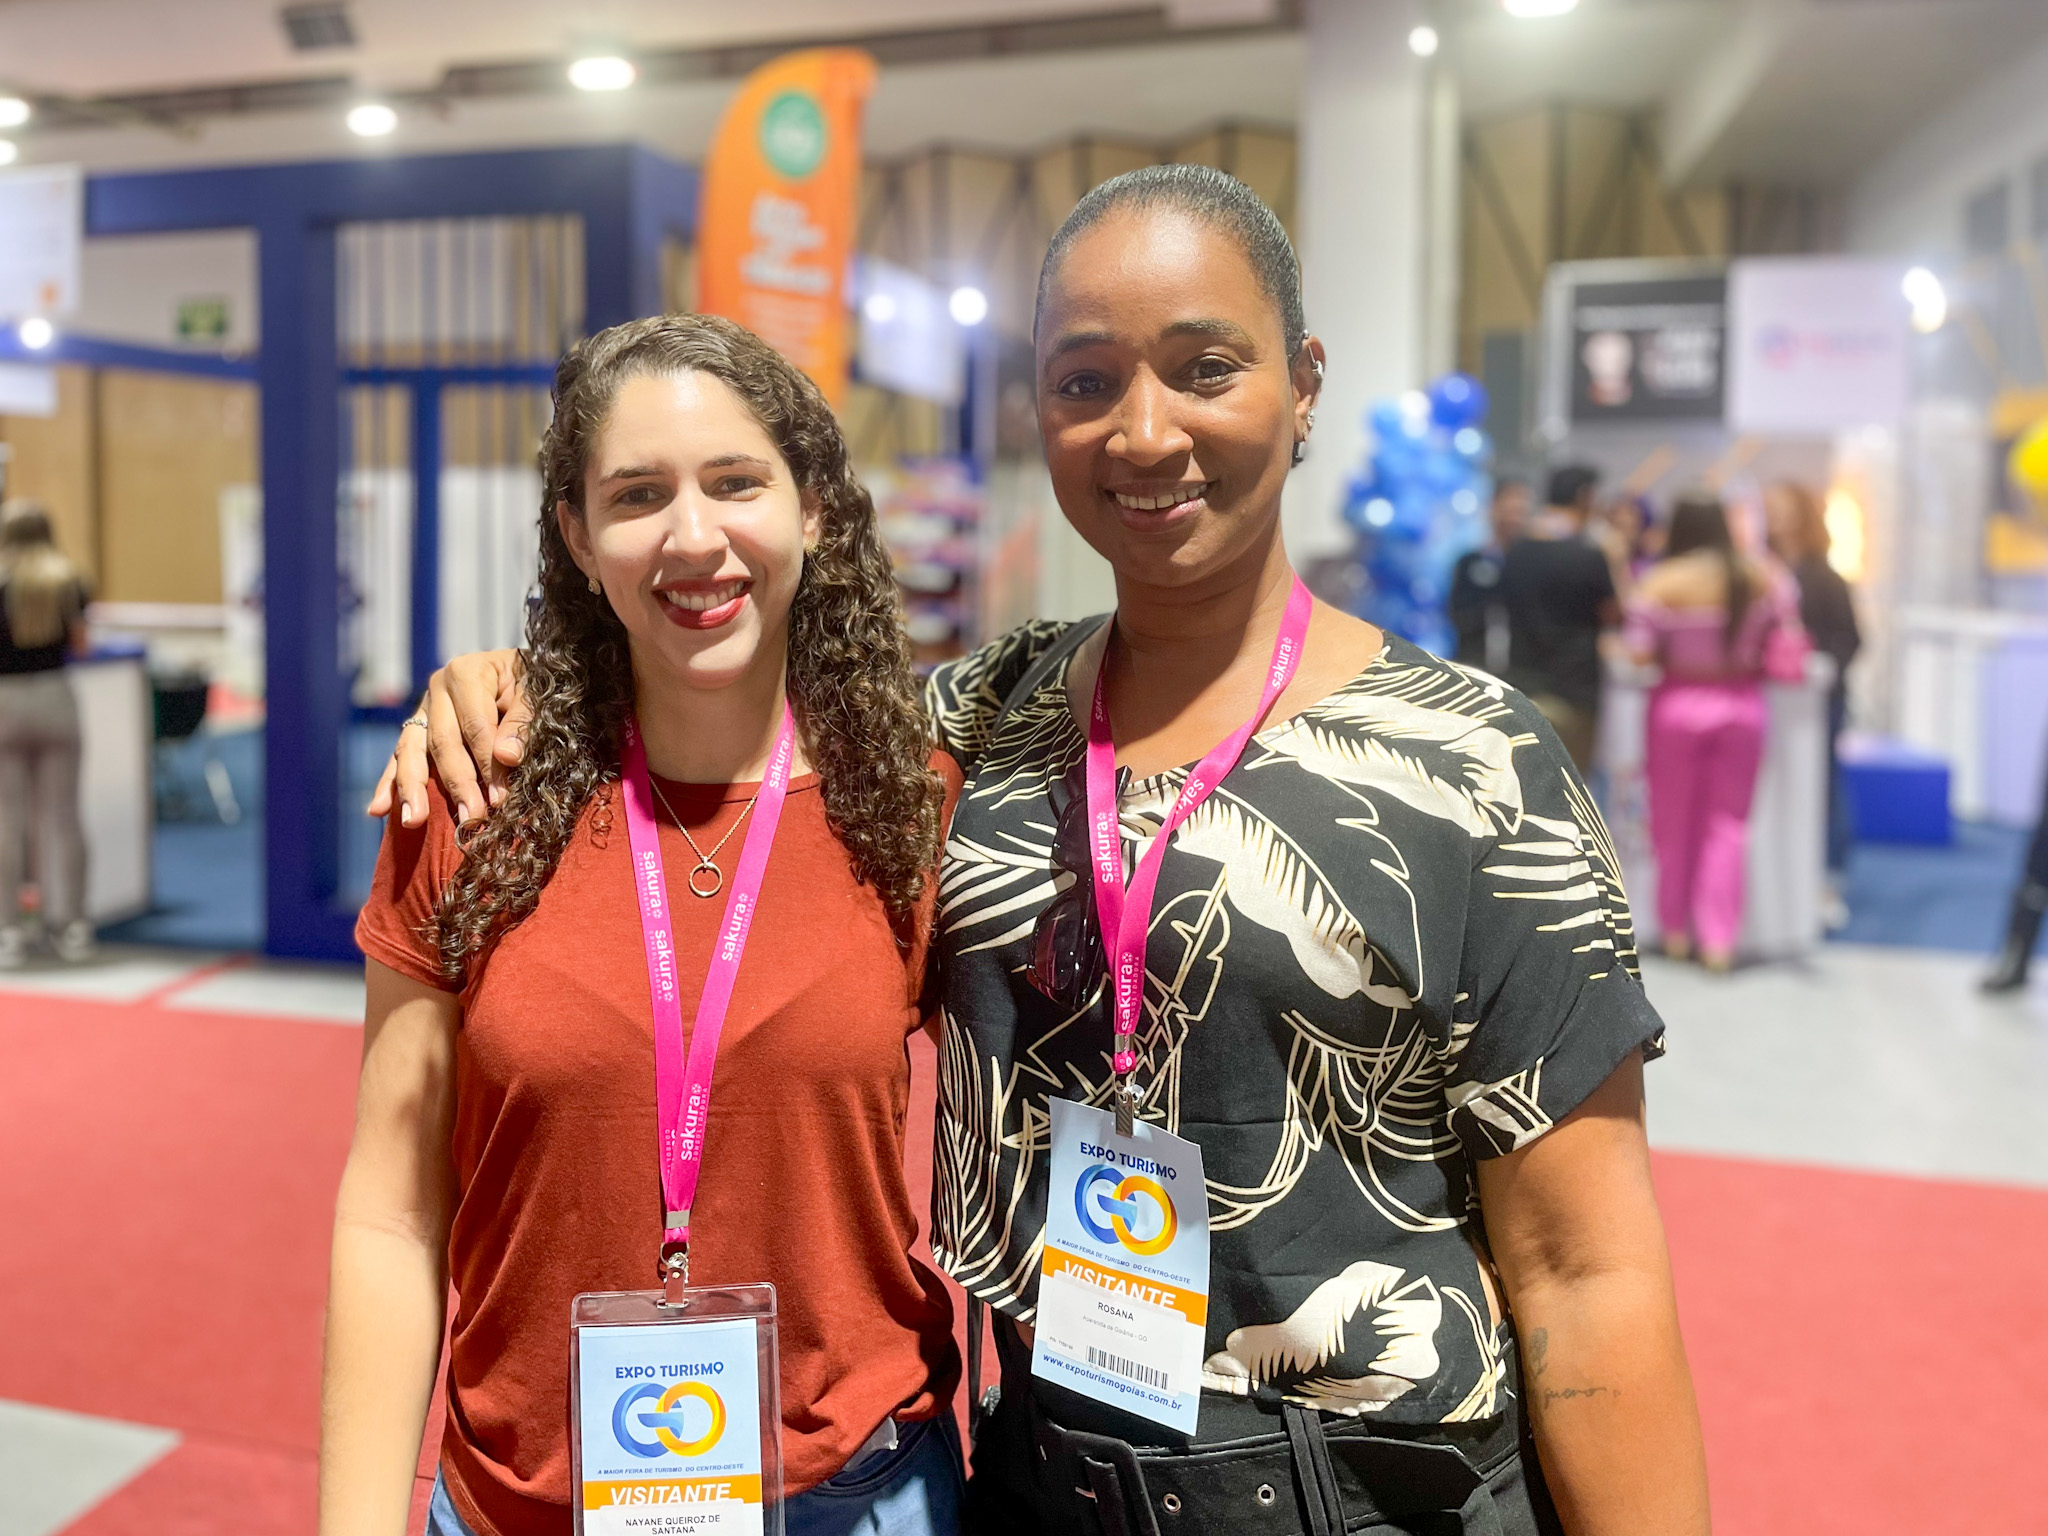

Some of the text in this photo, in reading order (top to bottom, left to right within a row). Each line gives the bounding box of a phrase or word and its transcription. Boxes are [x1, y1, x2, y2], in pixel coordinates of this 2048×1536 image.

[1272, 644, 1292, 690] sakura
[769, 739, 790, 789] sakura
[1096, 821, 1114, 883] sakura
[643, 851, 662, 908] sakura
[721, 903, 747, 962] sakura
[655, 930, 674, 991] sakura
[1120, 964, 1133, 1031] sakura
[680, 1095, 701, 1161] sakura
[1080, 1142, 1177, 1181] EXPO TURISMO
[1061, 1240, 1079, 1250] MAIOR
[1079, 1245, 1095, 1256] FEIRA
[1095, 1251, 1103, 1259] DE
[1104, 1254, 1130, 1267] TURISMO
[1143, 1266, 1191, 1285] CENTRO-OESTE
[1065, 1260, 1177, 1308] VISITANTE
[1097, 1302, 1135, 1321] ROSANA
[615, 1361, 724, 1379] EXPO TURISMO
[1043, 1353, 1183, 1411] www.expoturismogoias.com.br
[696, 1463, 744, 1472] CENTRO-OESTE
[610, 1483, 732, 1505] VISITANTE
[625, 1514, 721, 1527] NAYANE QUEIROZ DE
[651, 1526, 696, 1536] SANTANA
